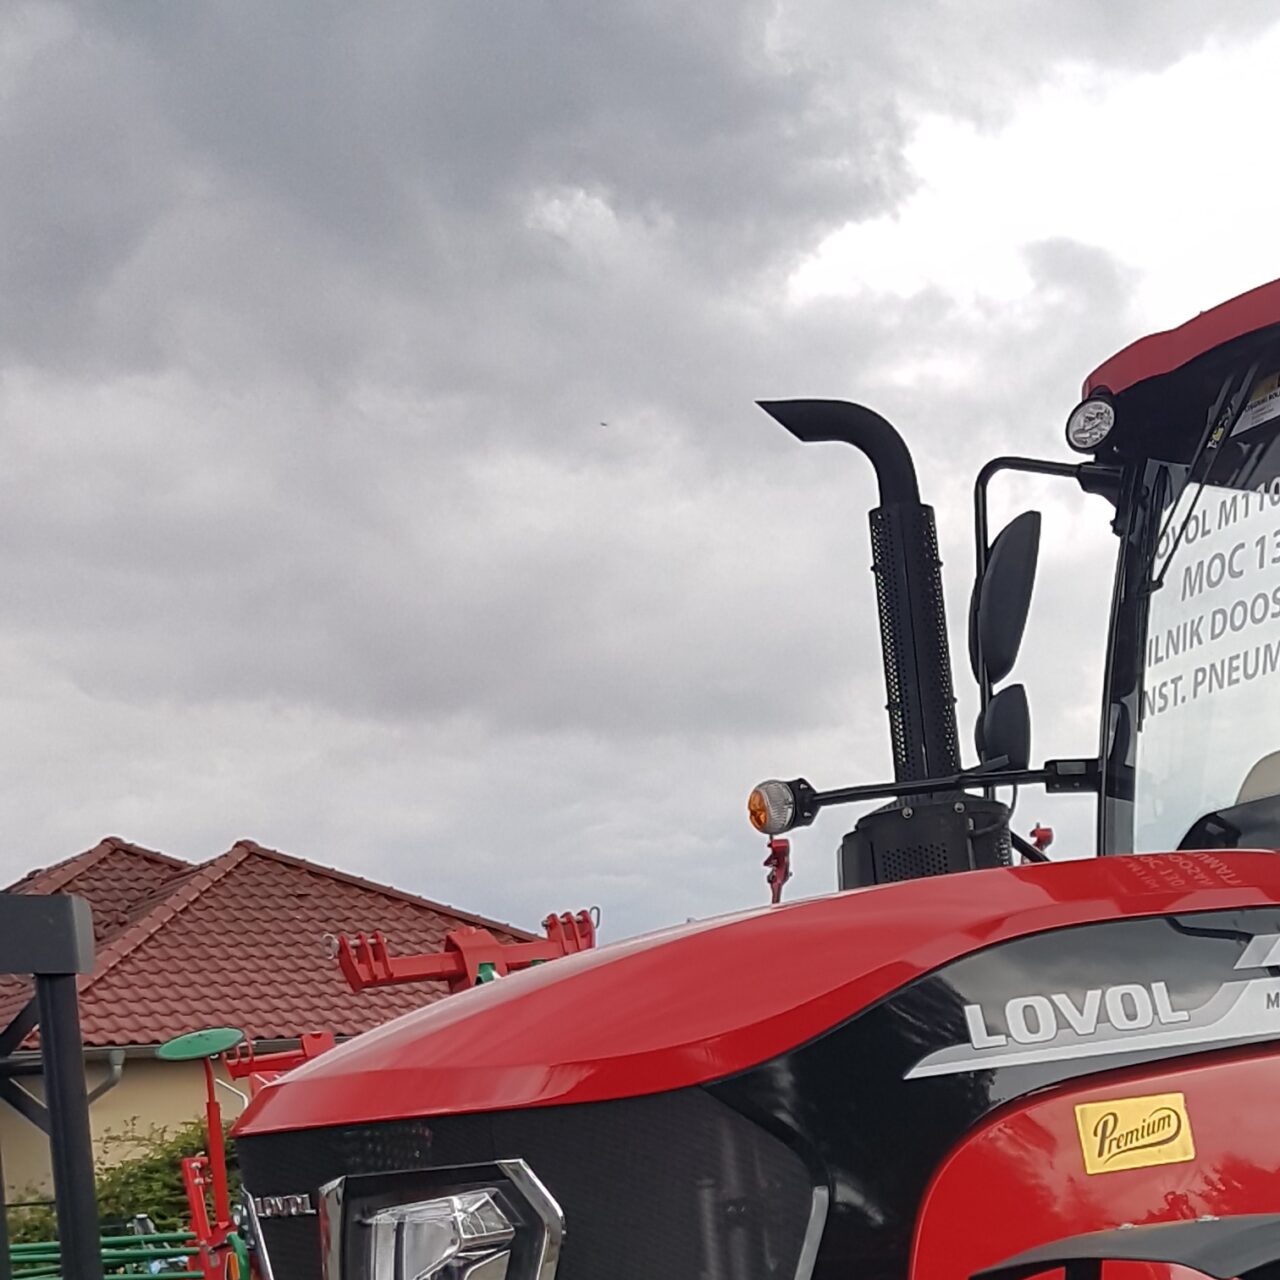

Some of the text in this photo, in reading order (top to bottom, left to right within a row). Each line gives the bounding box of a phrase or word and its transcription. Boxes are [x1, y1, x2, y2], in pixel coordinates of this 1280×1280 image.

[1181, 542, 1246, 601] MOC
[1147, 615, 1204, 668] ILNIK
[964, 981, 1190, 1050] LOVOL
[1092, 1106, 1182, 1165] Premium
